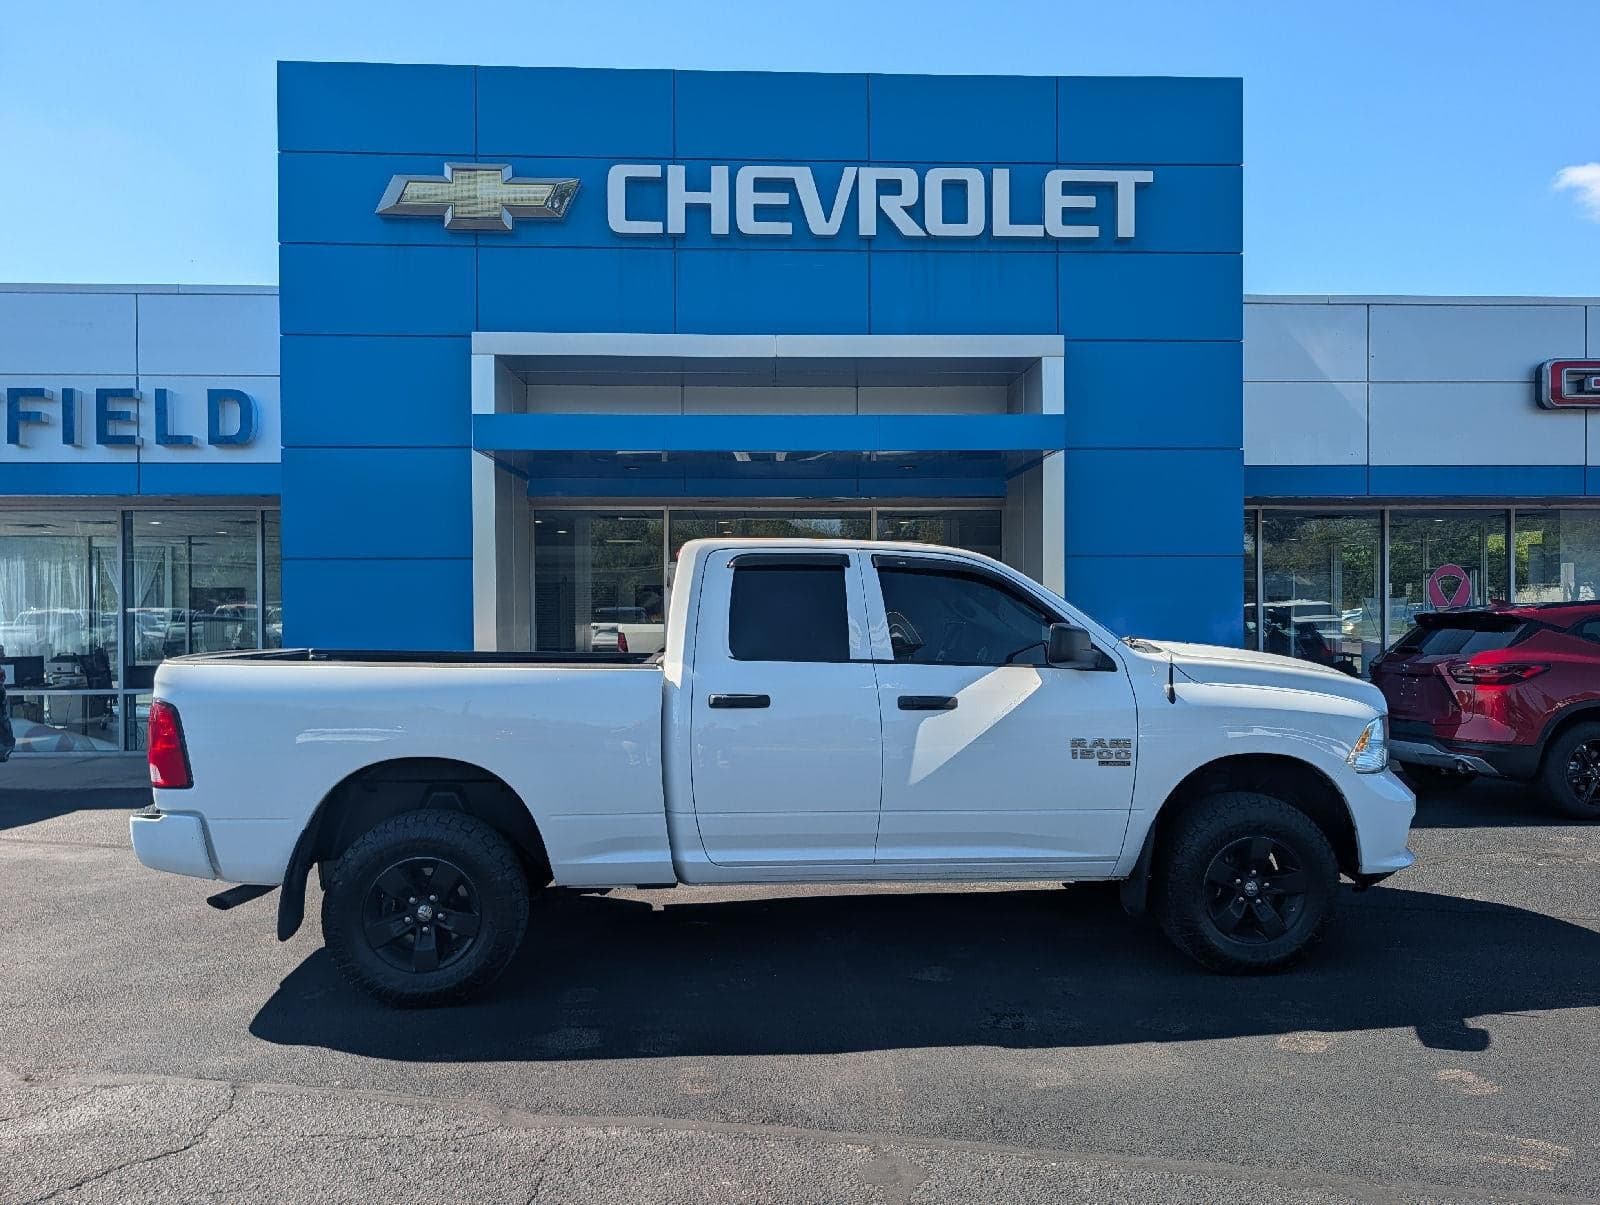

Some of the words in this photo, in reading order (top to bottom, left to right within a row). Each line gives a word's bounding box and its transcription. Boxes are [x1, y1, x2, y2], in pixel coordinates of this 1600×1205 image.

[607, 164, 1154, 239] CHEVROLET
[6, 387, 258, 447] FIELD
[1070, 737, 1131, 748] RAM
[1071, 748, 1131, 759] 1500
